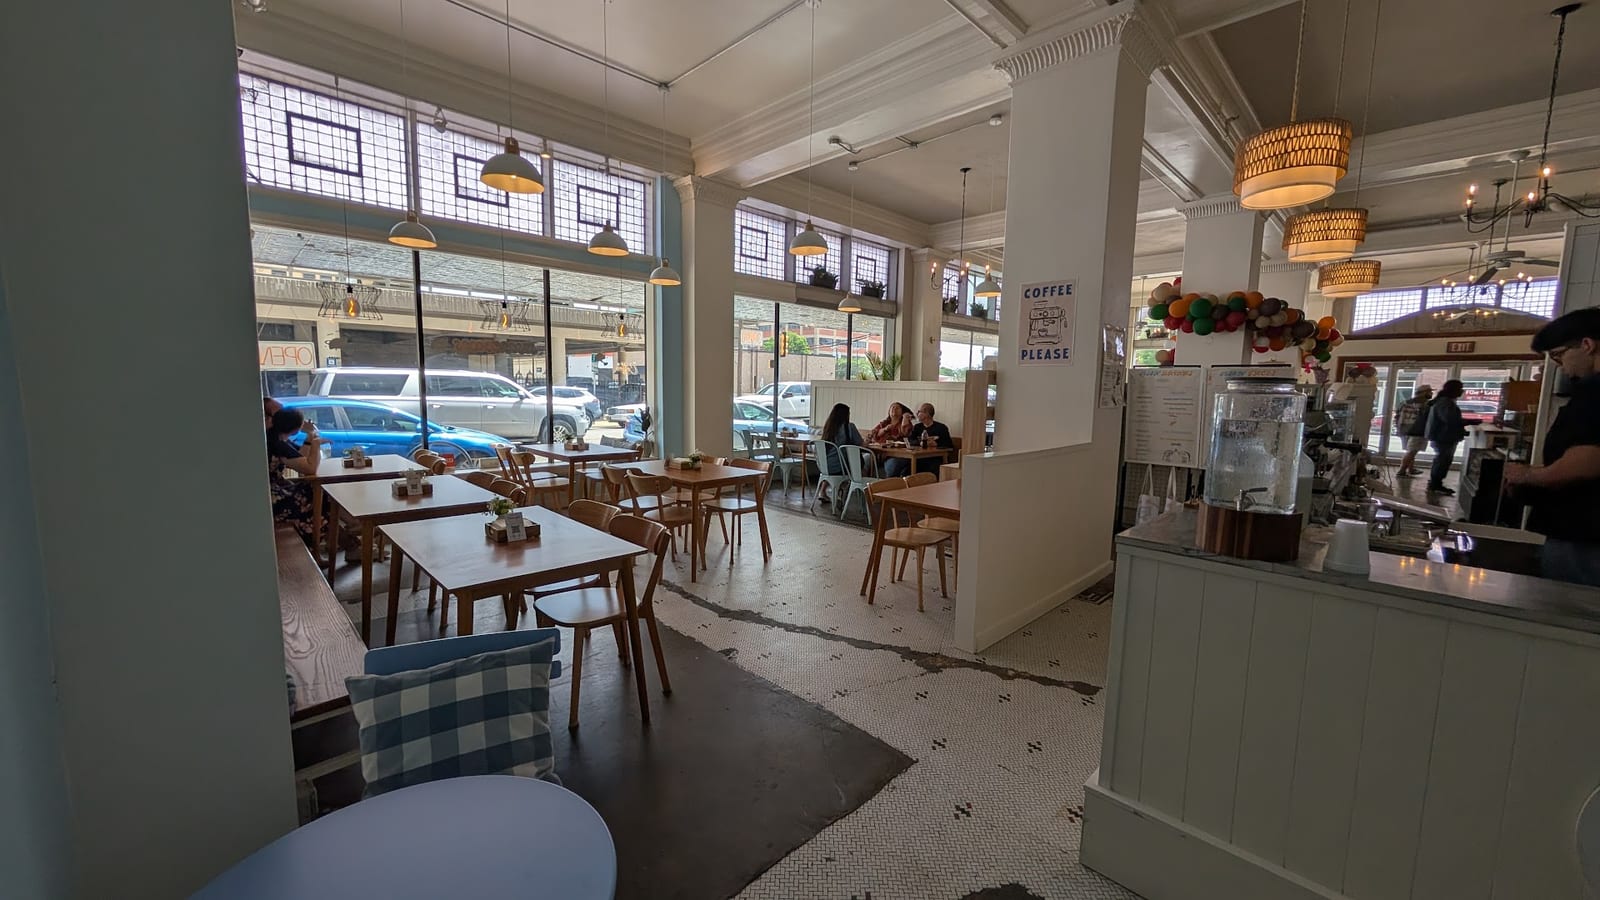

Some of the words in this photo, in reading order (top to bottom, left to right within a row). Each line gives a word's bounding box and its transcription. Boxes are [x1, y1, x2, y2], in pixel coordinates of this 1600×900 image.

[1024, 284, 1072, 299] COFFEE
[1451, 343, 1471, 352] EXIT
[1021, 348, 1070, 360] PLEASE
